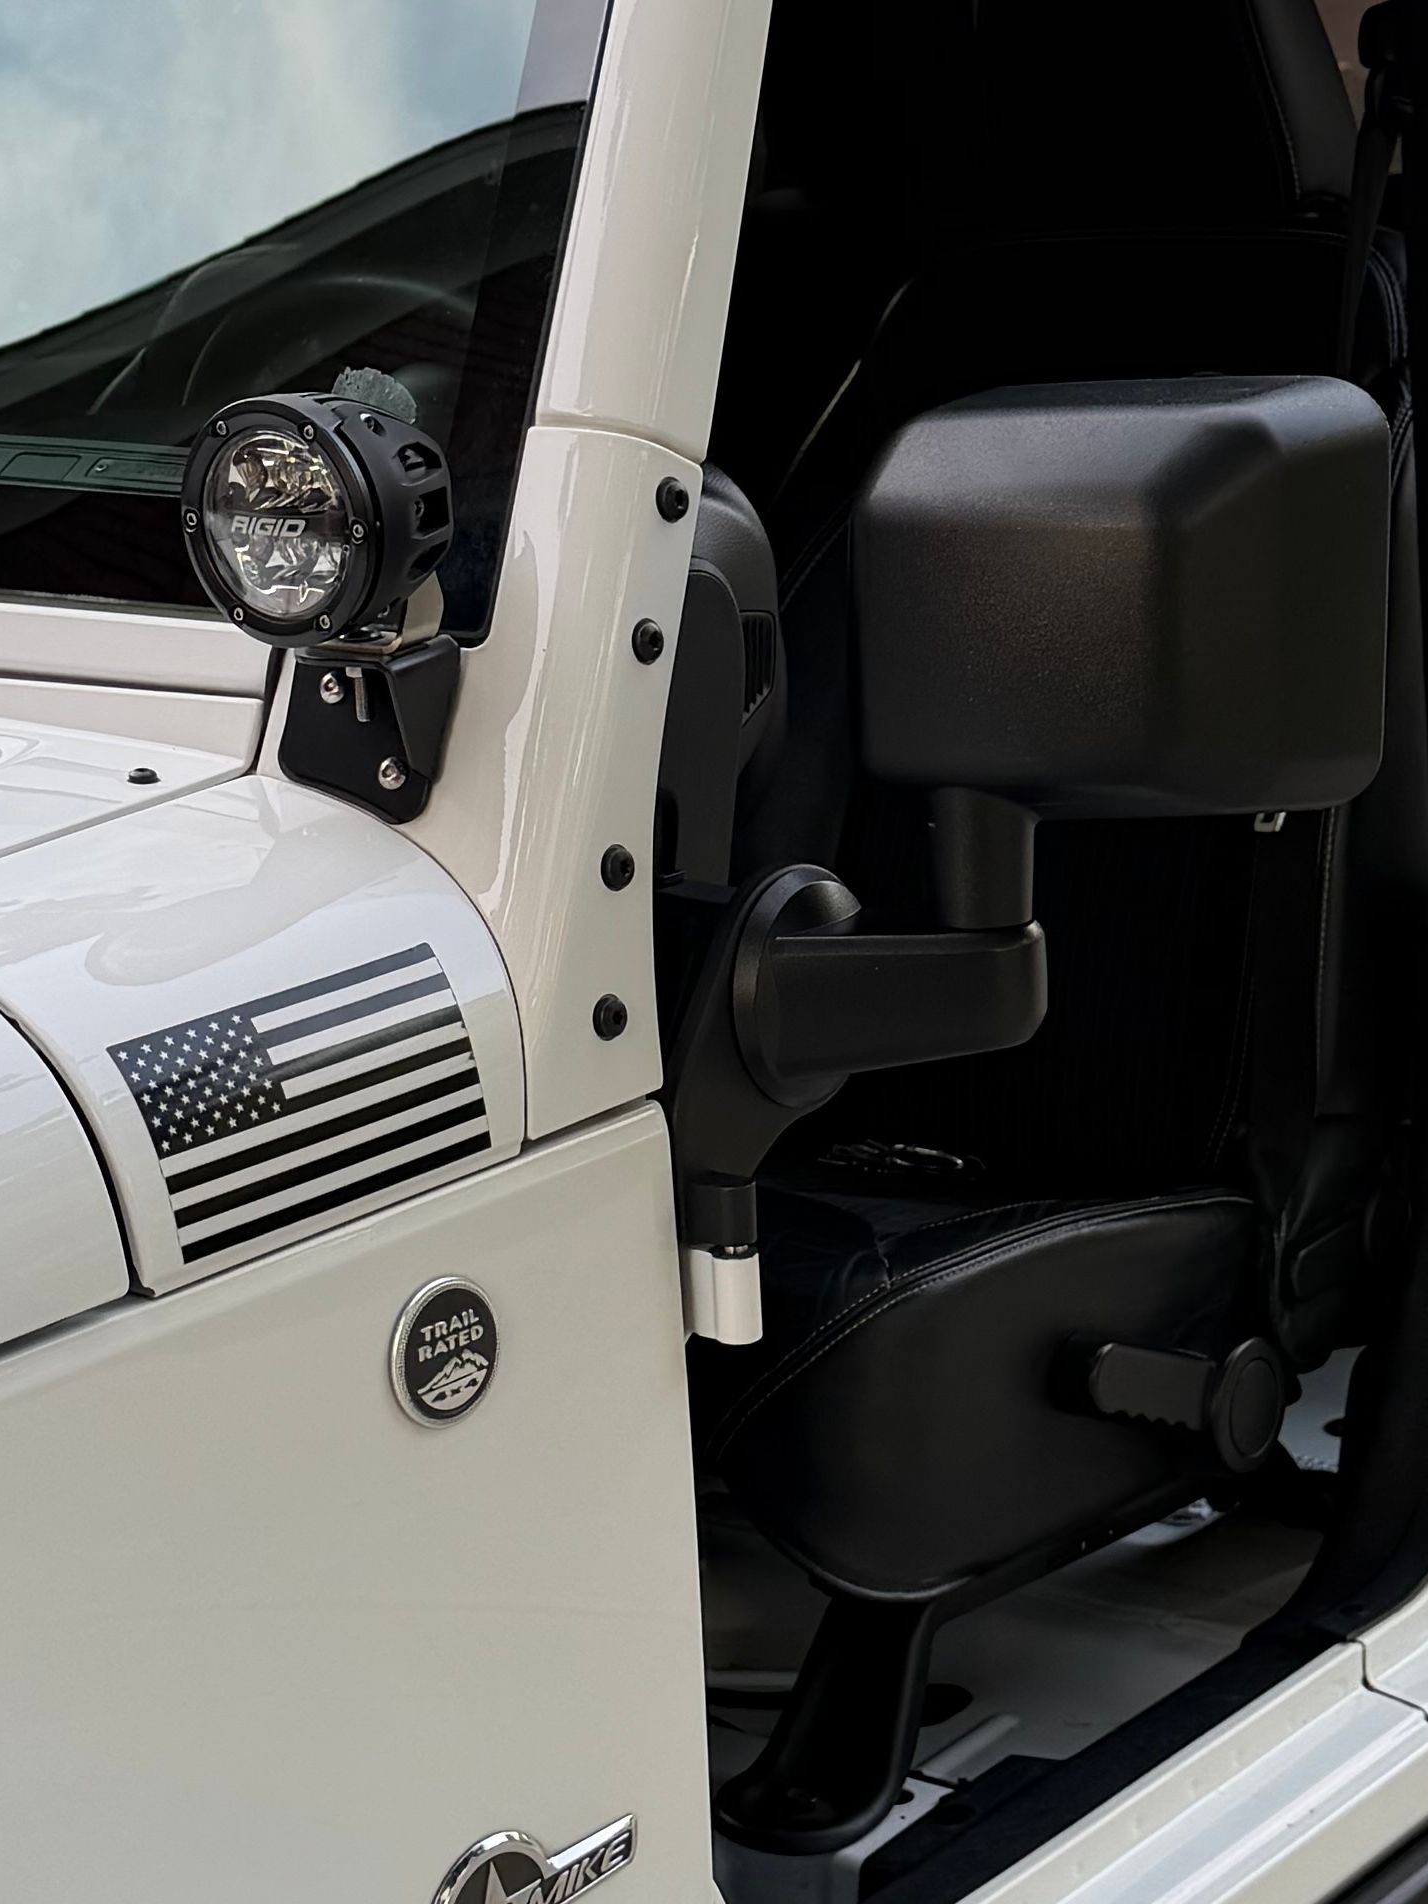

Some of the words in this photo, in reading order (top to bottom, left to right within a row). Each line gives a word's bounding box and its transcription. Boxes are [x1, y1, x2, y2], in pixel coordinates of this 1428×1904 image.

[231, 515, 306, 537] RIGID
[420, 1308, 479, 1342] TRAIL
[418, 1325, 483, 1362] RATED
